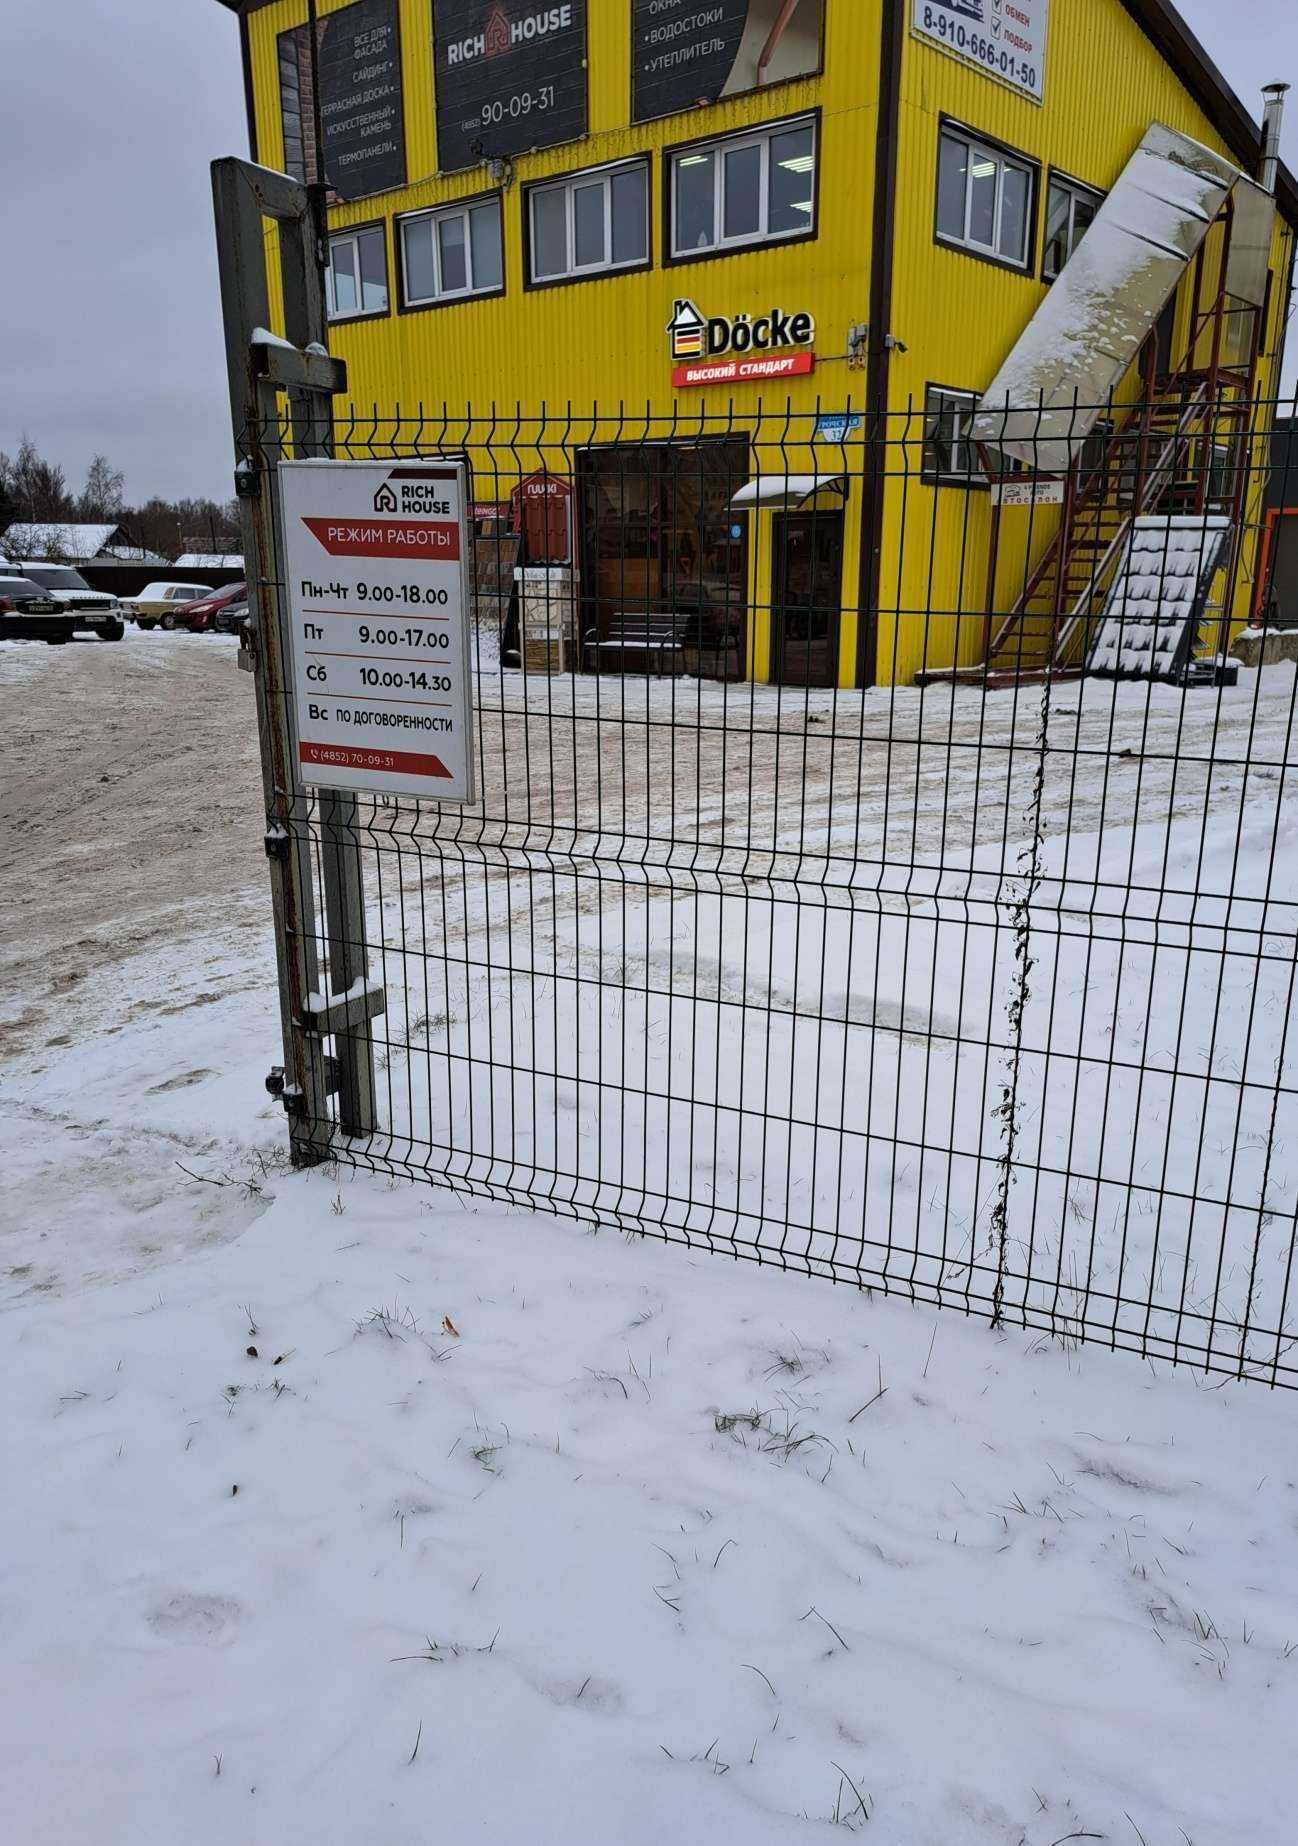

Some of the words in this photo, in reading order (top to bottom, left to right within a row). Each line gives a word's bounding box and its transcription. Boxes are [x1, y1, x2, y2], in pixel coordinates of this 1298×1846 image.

[447, 33, 485, 65] RICH
[511, 4, 571, 43] HOUSE
[651, 7, 723, 43] ВОДОСТОКИ
[354, 33, 369, 47] ВСЕ
[354, 39, 388, 59] ФАСАДА
[924, 6, 1036, 88] 8-910-666-01-50
[1004, 29, 1032, 54] ПОДБОР
[650, 38, 725, 72] УТЕПЛИТЕЛЬ
[352, 62, 388, 83] САЙДИНГ
[363, 85, 390, 104] ДОСКА
[482, 86, 554, 125] 90-09-31
[327, 104, 391, 136] ИСКУССТВЕННЫЙ
[360, 121, 392, 138] КАМЕНЬ
[338, 140, 393, 166] ТЕРМОПАНЕЛИ
[707, 308, 813, 355] Döcke
[686, 362, 735, 381] ВЫСОКИЙ
[739, 358, 795, 376] СТАНДАРТ
[401, 485, 434, 498] RICH
[402, 501, 450, 514] HOUSE
[328, 527, 383, 543] РЕЖИМ
[387, 530, 450, 545] РАБОТЫ
[301, 581, 349, 599] Пн-Чт
[356, 582, 448, 605] 9.00-18.00
[304, 623, 323, 640] Пт
[359, 625, 449, 649] 9.00-17.00
[306, 665, 327, 682] Сб
[360, 668, 451, 692] 10.00-14.30
[309, 704, 328, 720] Вс
[336, 709, 350, 722] ПО
[354, 711, 453, 732] ДОГОВОРЕННОСТИ
[320, 750, 349, 764] (4852)
[352, 753, 394, 766] 70-09-31
